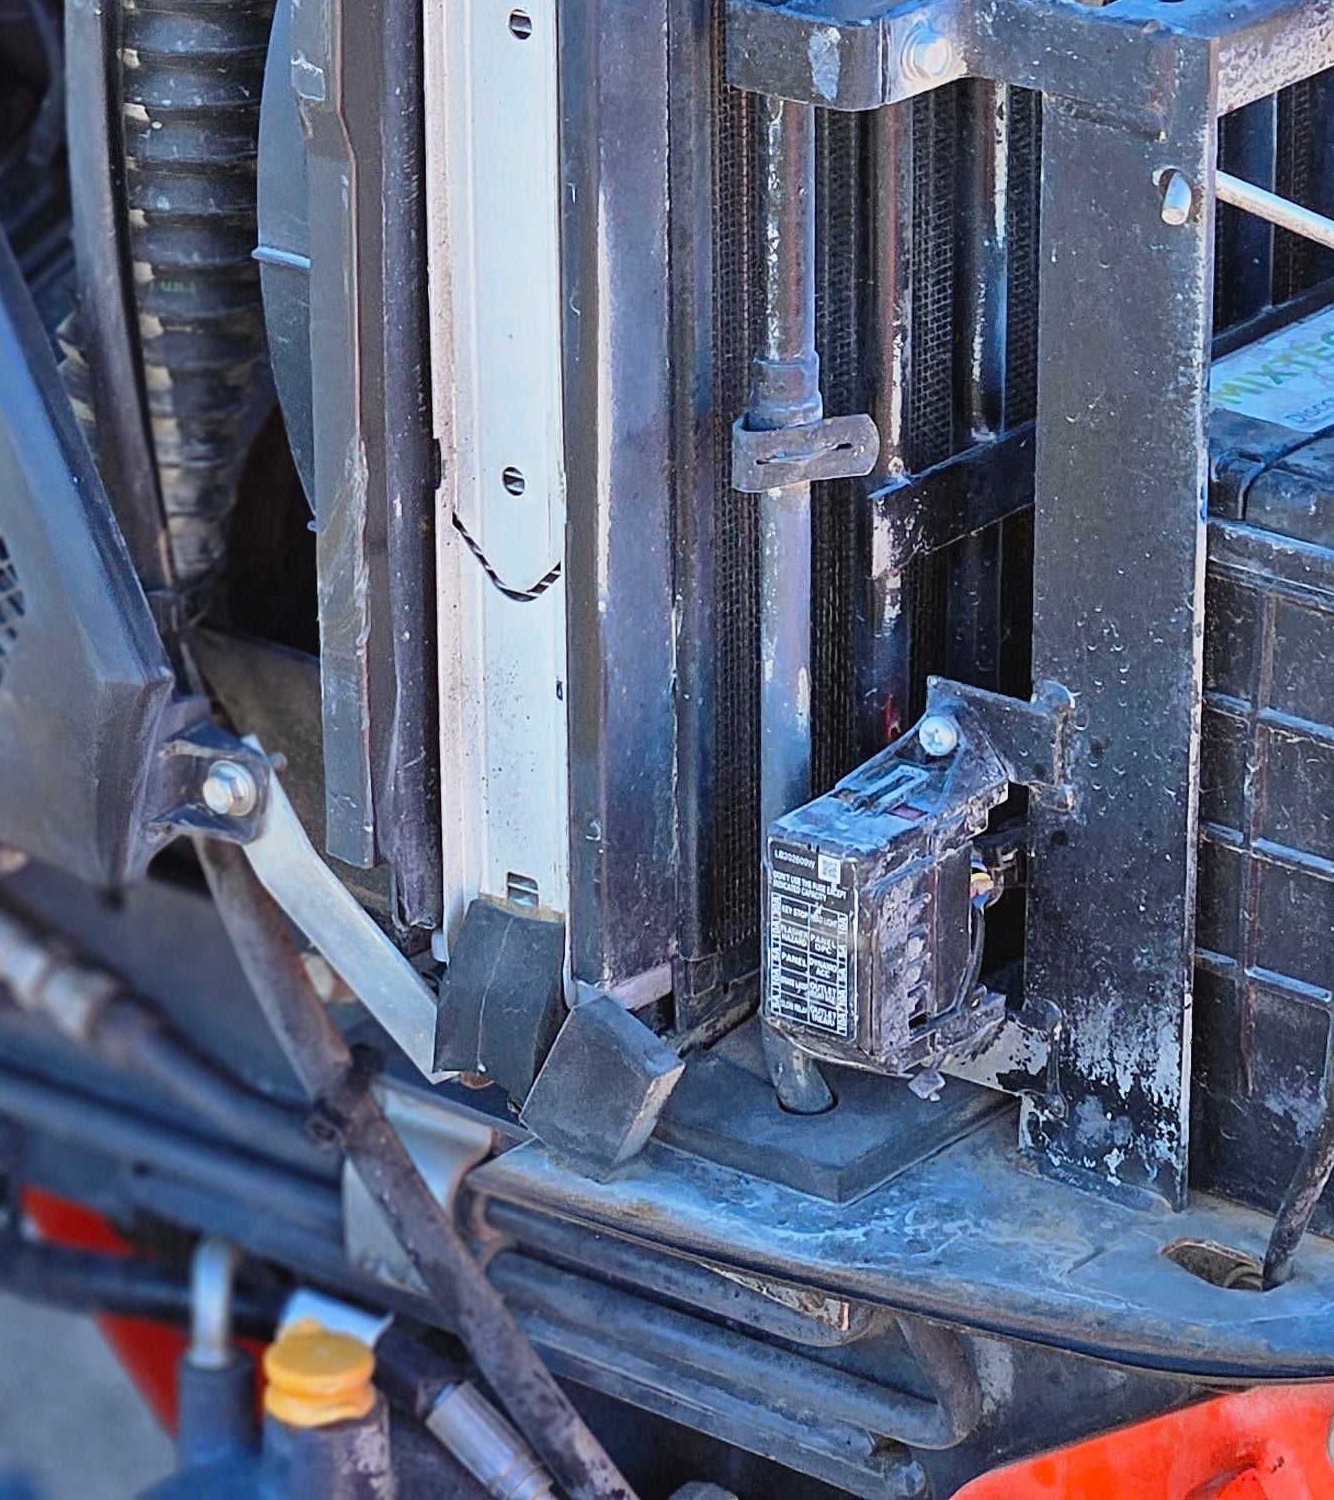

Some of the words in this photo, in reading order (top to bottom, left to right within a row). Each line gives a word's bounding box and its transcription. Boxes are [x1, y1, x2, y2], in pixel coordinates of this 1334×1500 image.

[810, 933, 837, 949] PANEL
[814, 943, 833, 955] OPC
[781, 951, 807, 968] PANEL
